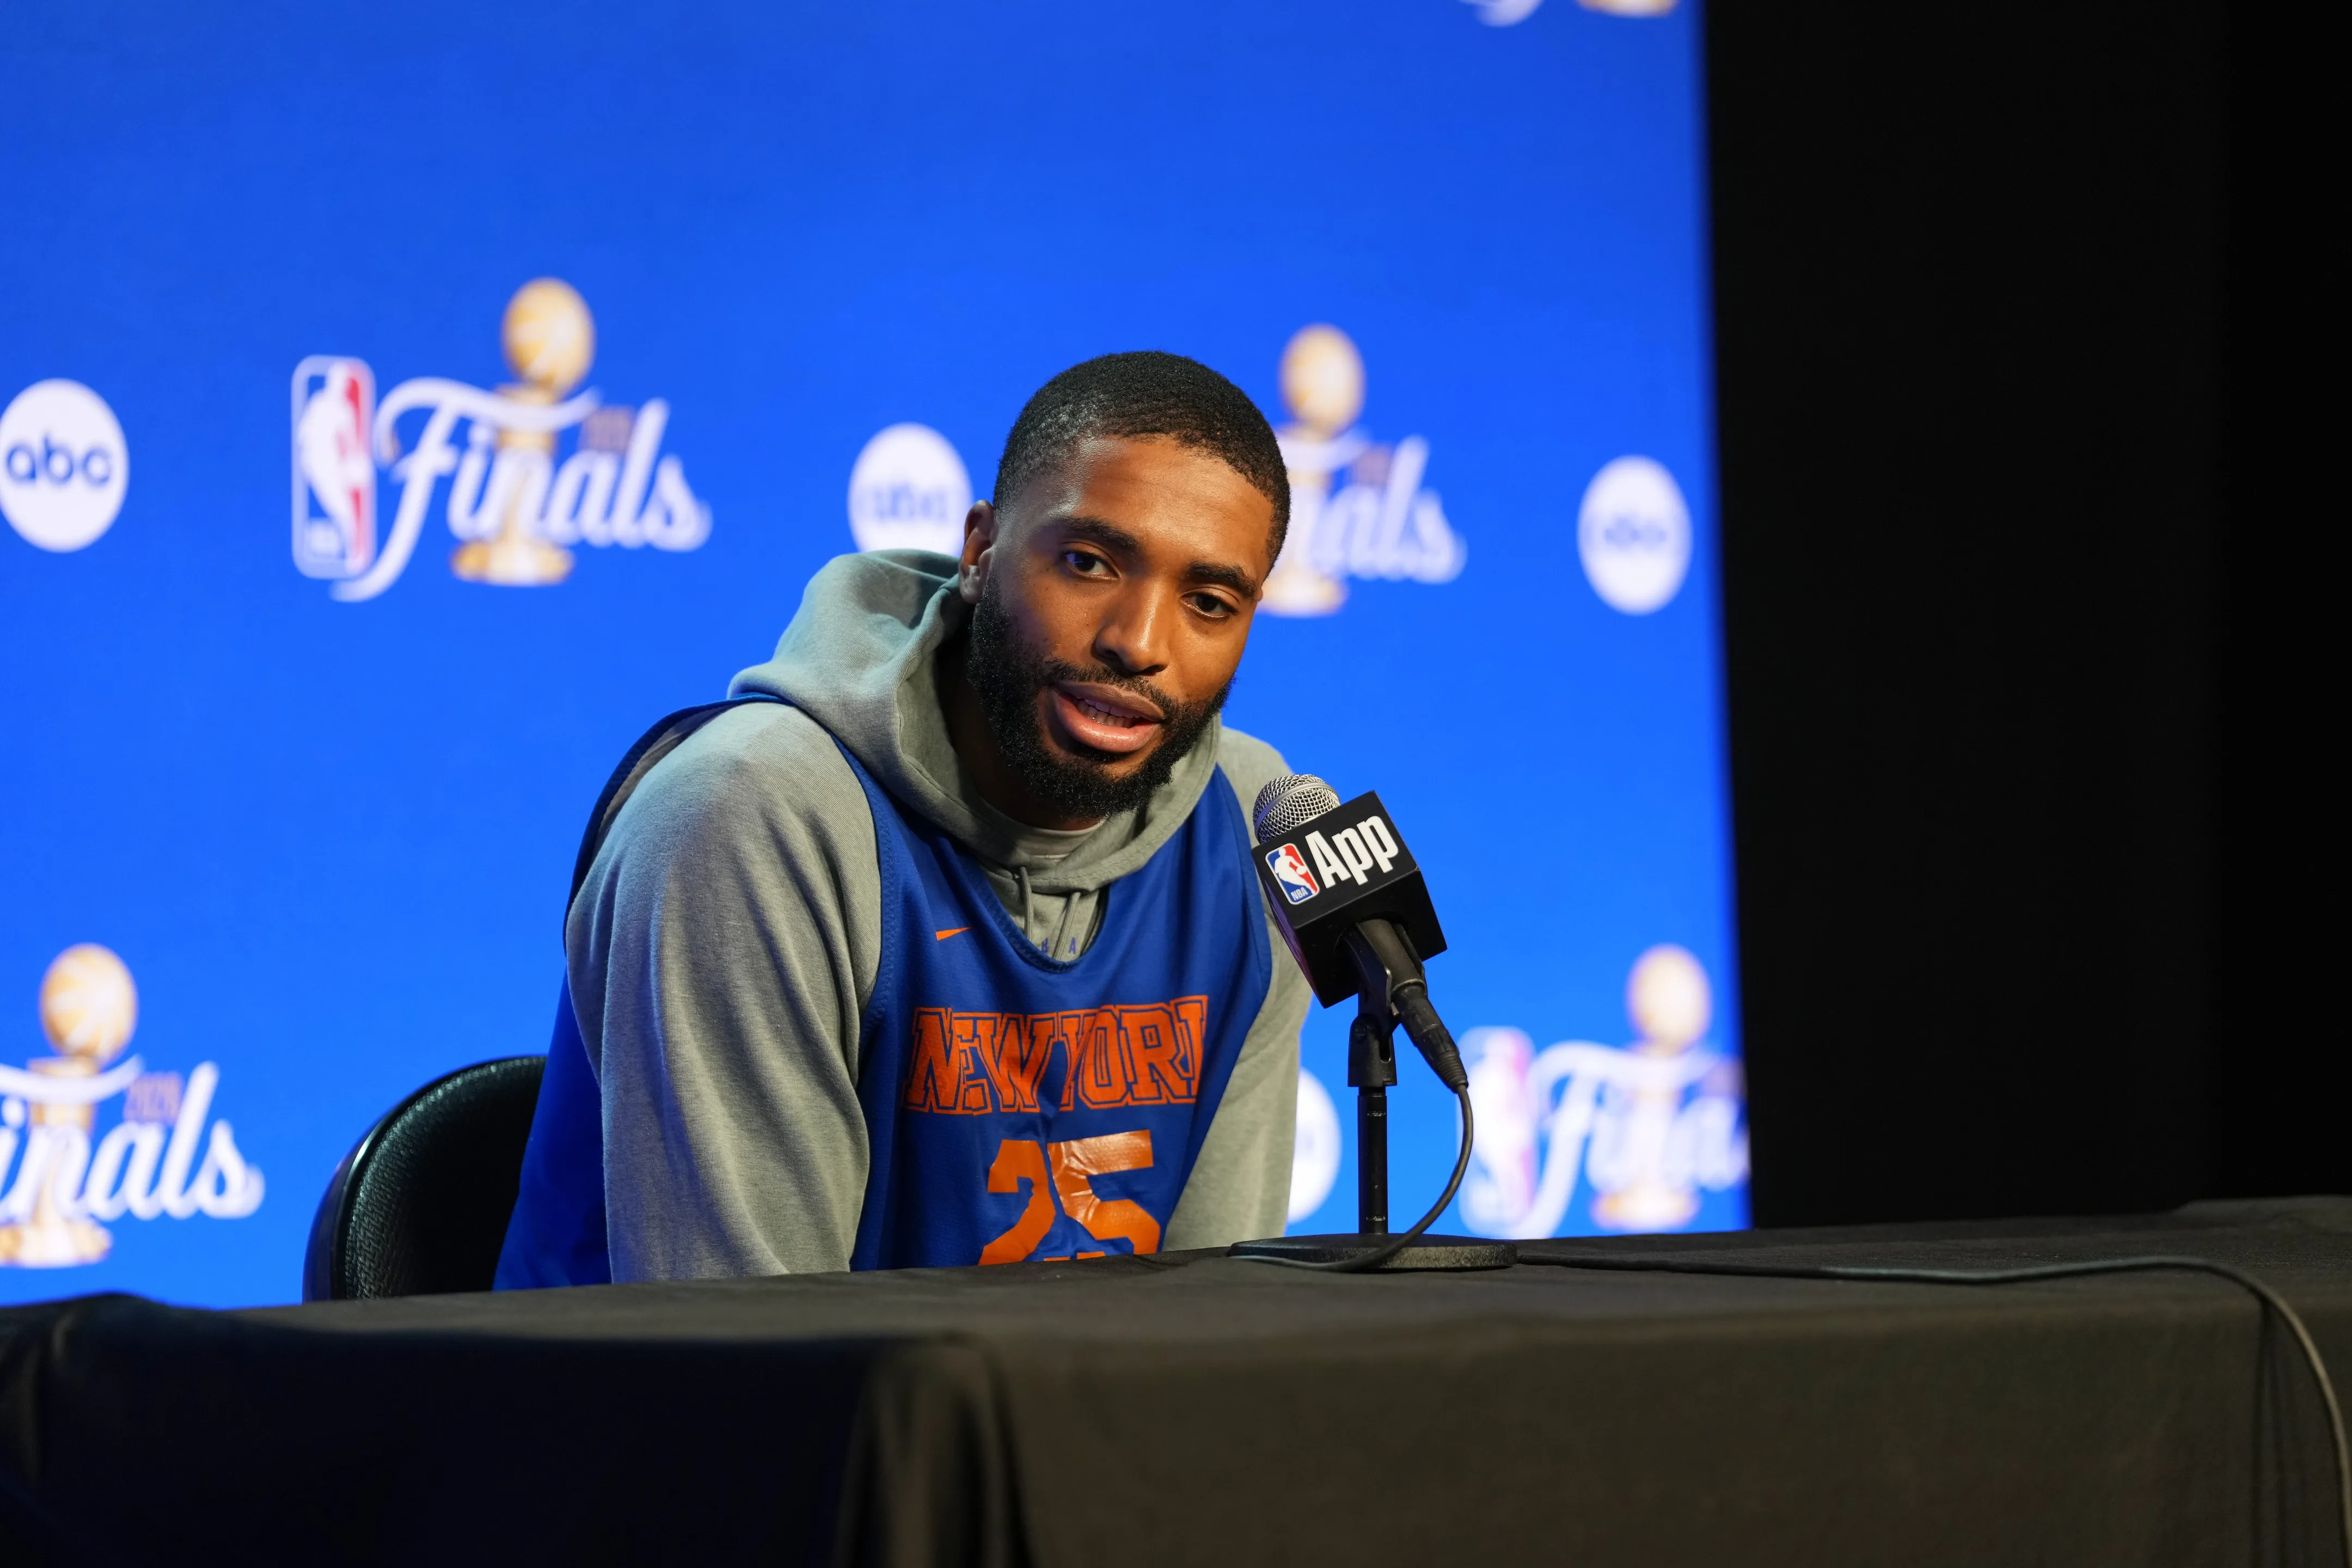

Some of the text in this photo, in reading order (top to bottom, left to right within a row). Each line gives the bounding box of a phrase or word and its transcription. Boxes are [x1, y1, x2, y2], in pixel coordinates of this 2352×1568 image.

[6, 432, 112, 486] abc
[330, 376, 712, 603] Finals
[1290, 886, 1309, 901] NBA
[1304, 816, 1399, 889] App
[903, 1006, 1058, 1116] NEW
[0, 1053, 265, 1221] inals
[977, 1129, 1161, 1266] 25
